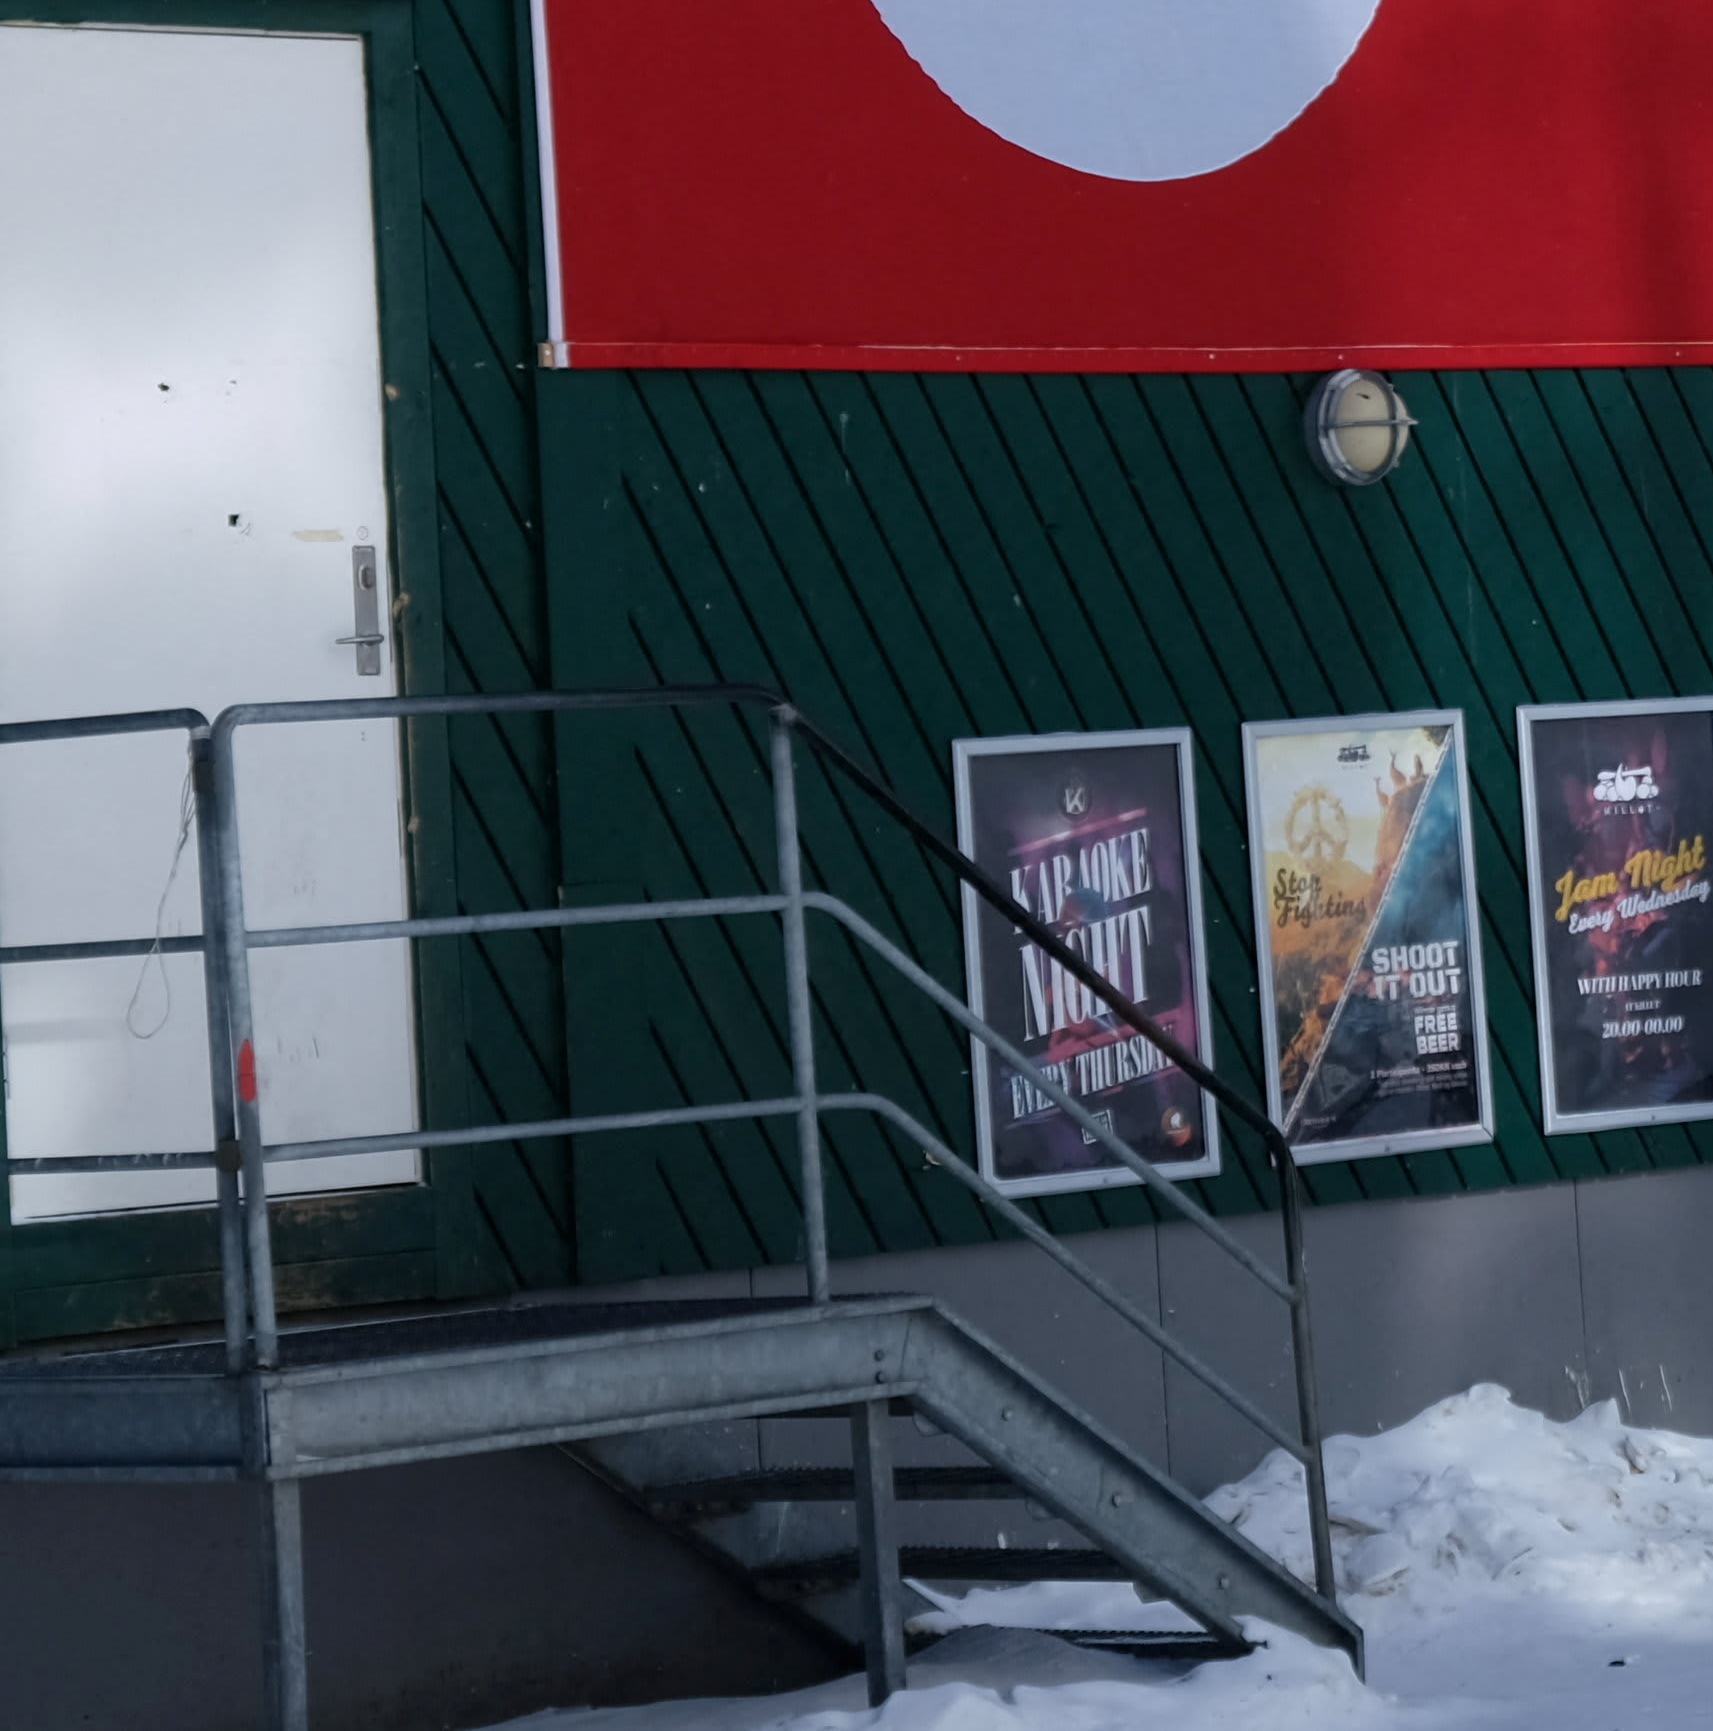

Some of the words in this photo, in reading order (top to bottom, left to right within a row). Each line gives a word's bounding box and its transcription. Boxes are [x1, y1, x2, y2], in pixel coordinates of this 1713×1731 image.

[1009, 828, 1151, 935] KARAOKE
[1555, 870, 1621, 923] Jam
[1624, 835, 1707, 892] Night
[1568, 908, 1614, 934] Every
[1616, 879, 1711, 919] Wednesday
[1019, 904, 1151, 1043] NIGHT
[1371, 940, 1459, 974] SHOOT
[1373, 974, 1401, 1001] IT
[1409, 968, 1462, 998] OUT
[1577, 975, 1615, 996] WITH
[1617, 972, 1662, 992] HAPPY
[1664, 969, 1702, 988] HOUR
[1414, 1012, 1458, 1035] FREE
[1416, 1033, 1460, 1055] BEER
